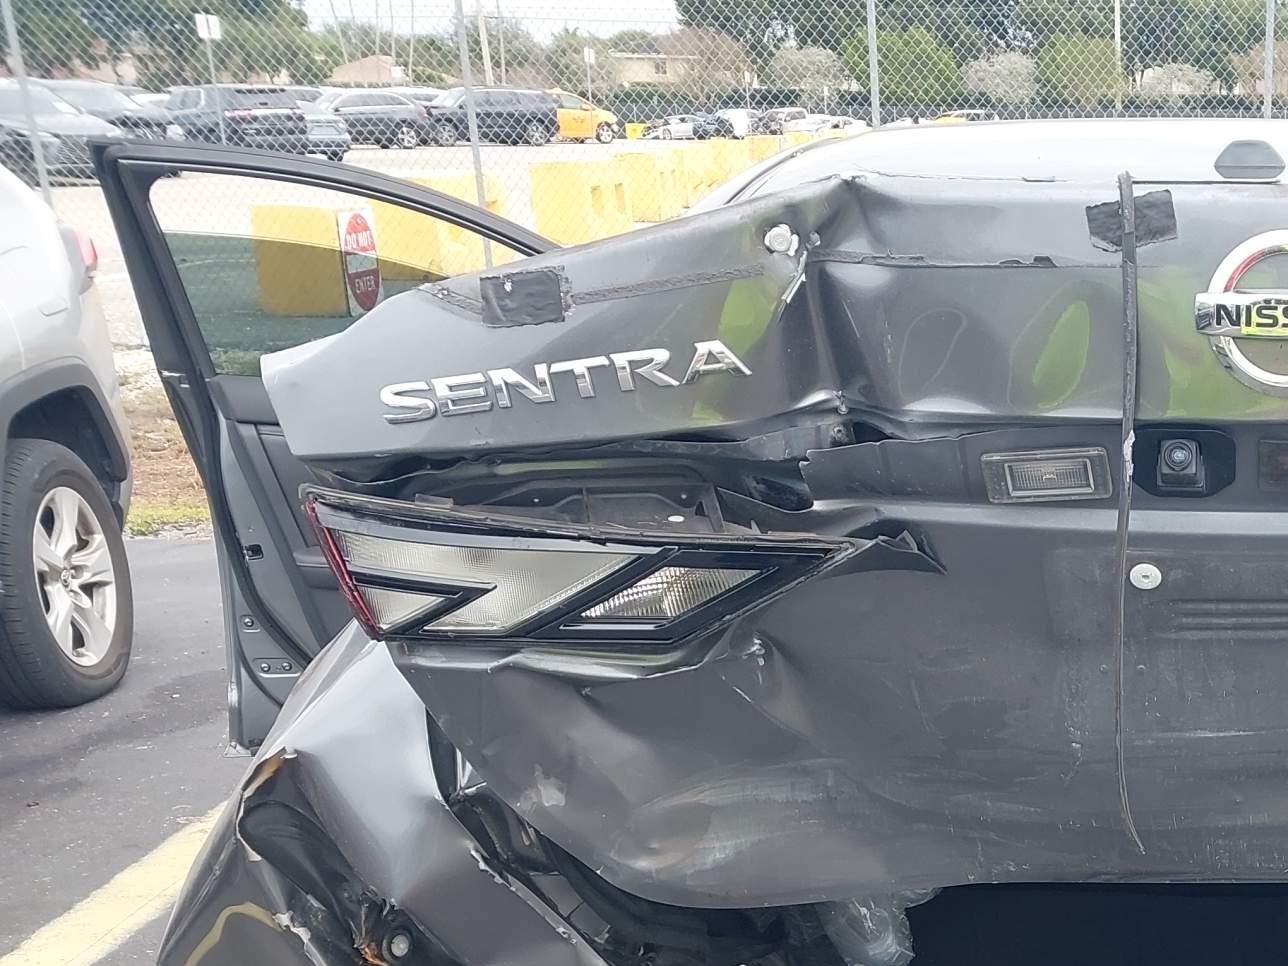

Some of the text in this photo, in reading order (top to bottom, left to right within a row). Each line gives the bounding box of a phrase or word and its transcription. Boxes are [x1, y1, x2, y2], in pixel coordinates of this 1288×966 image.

[345, 230, 373, 250] DO NOT
[355, 275, 376, 293] ENTER
[380, 339, 752, 424] SENTRA
